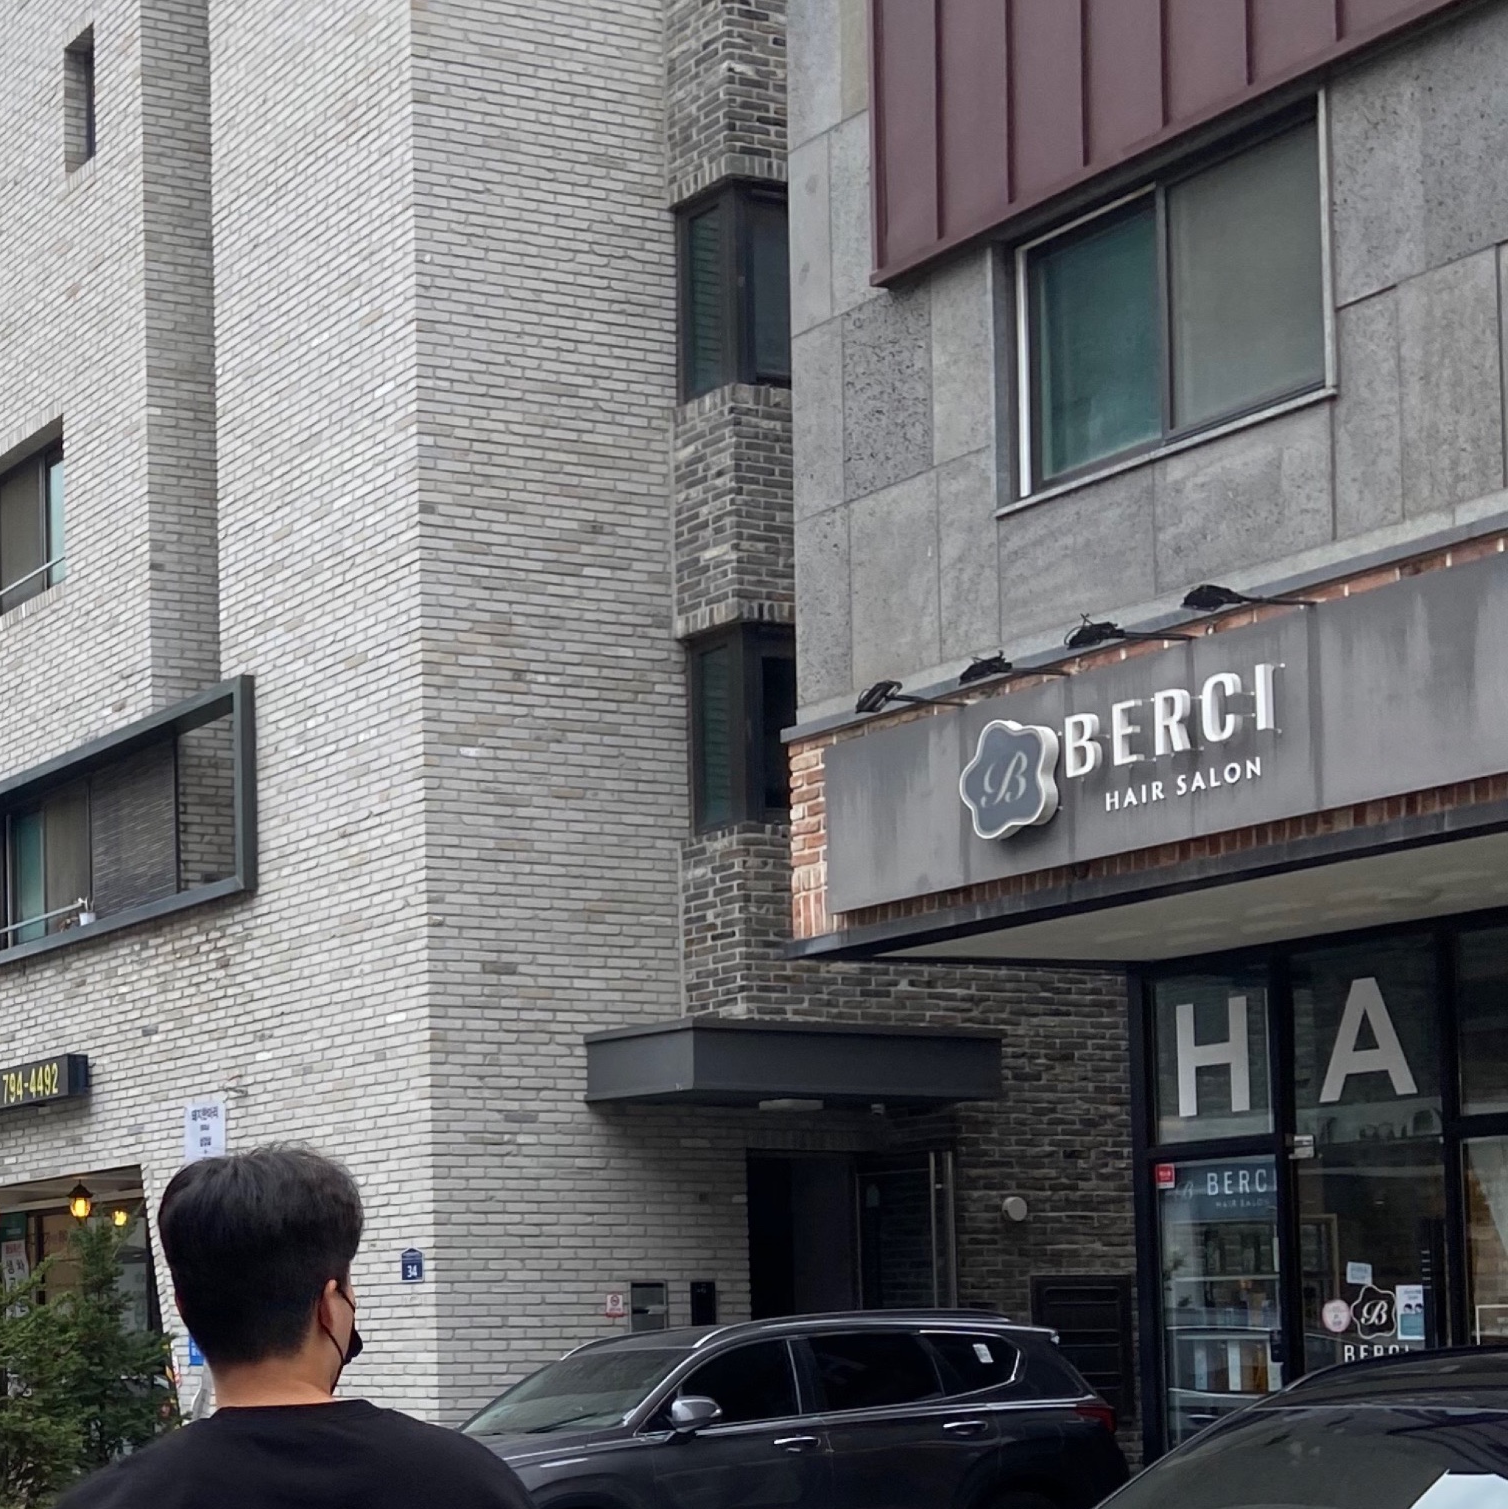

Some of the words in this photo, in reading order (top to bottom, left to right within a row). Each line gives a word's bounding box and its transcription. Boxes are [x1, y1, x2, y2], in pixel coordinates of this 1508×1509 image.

[1065, 664, 1274, 778] BERCI
[1105, 781, 1165, 811] HAIR
[1176, 757, 1261, 796] SALON
[407, 1264, 418, 1278] 34
